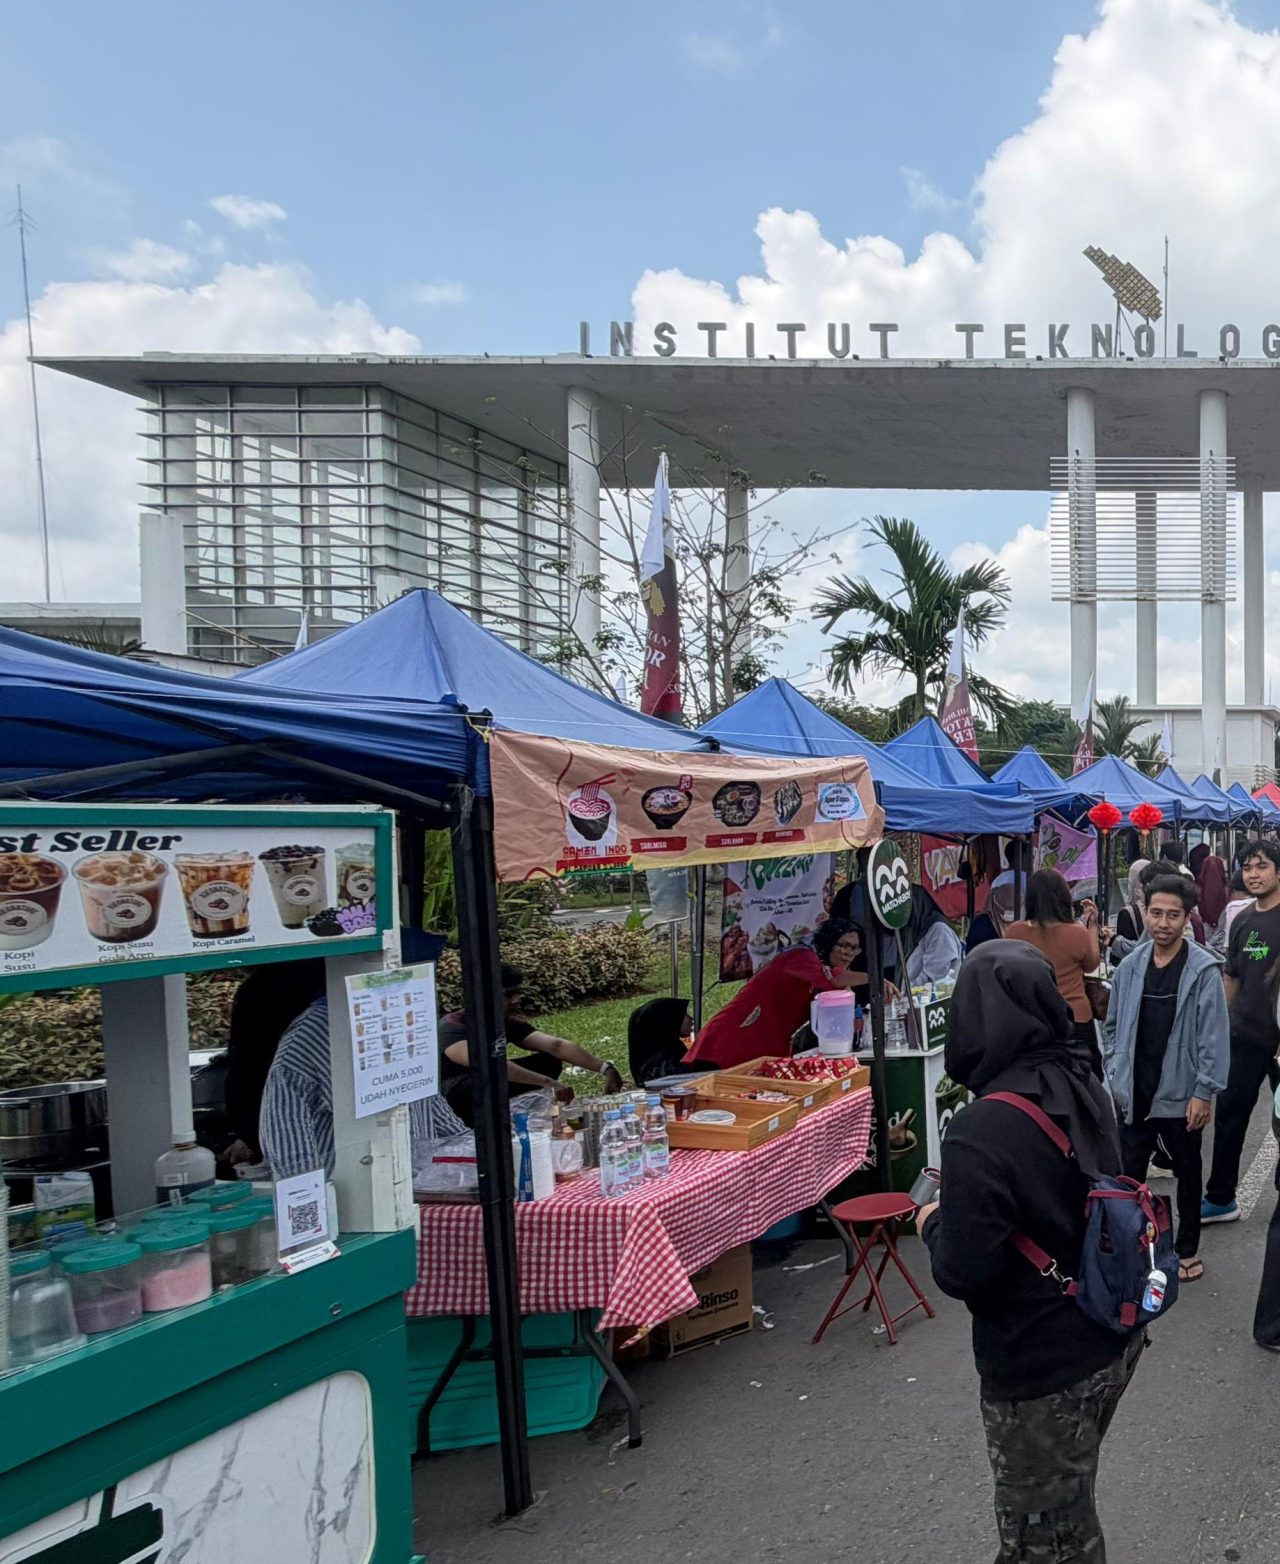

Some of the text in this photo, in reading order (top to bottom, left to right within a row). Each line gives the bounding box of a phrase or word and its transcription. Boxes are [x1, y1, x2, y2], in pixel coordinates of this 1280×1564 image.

[580, 321, 898, 359] INSTITUT
[50, 830, 183, 852] Seller
[605, 844, 628, 855] INDO
[98, 940, 154, 953] Kopi Susu
[192, 935, 256, 949] Kopi Caramel
[4, 951, 35, 964] Kopi
[4, 963, 37, 973] Susu
[372, 1074, 399, 1087] CUMA
[360, 1076, 434, 1105] UDAH NYEGERIN
[700, 1288, 739, 1309] Rinso
